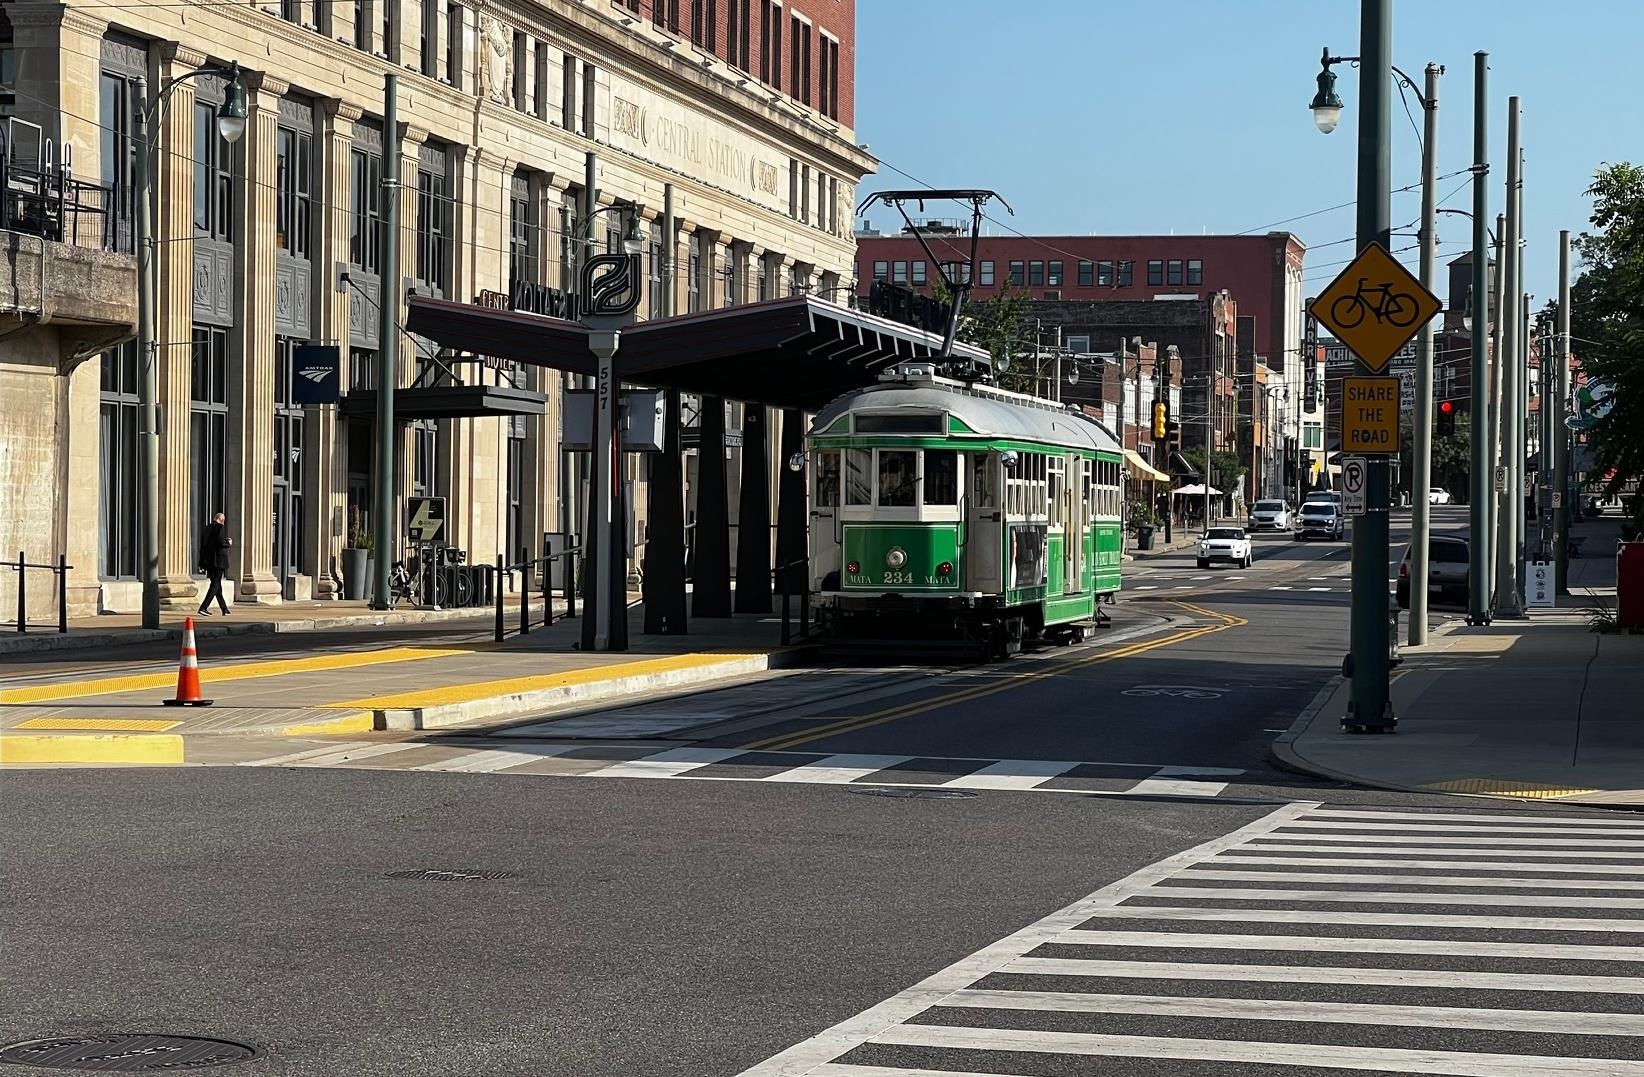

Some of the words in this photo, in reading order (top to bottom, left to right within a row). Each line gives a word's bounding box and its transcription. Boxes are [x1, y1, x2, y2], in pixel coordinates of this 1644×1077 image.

[656, 116, 700, 163] CENTRAL
[709, 137, 746, 184] STATION
[1306, 317, 1315, 397] ARRIVE
[600, 366, 609, 410] 557
[1348, 387, 1394, 401] SHARE
[1358, 408, 1384, 422] THE
[1352, 429, 1389, 443] ROAD
[850, 575, 872, 584] MATA
[884, 571, 913, 584] 234
[924, 575, 950, 584] MATA
